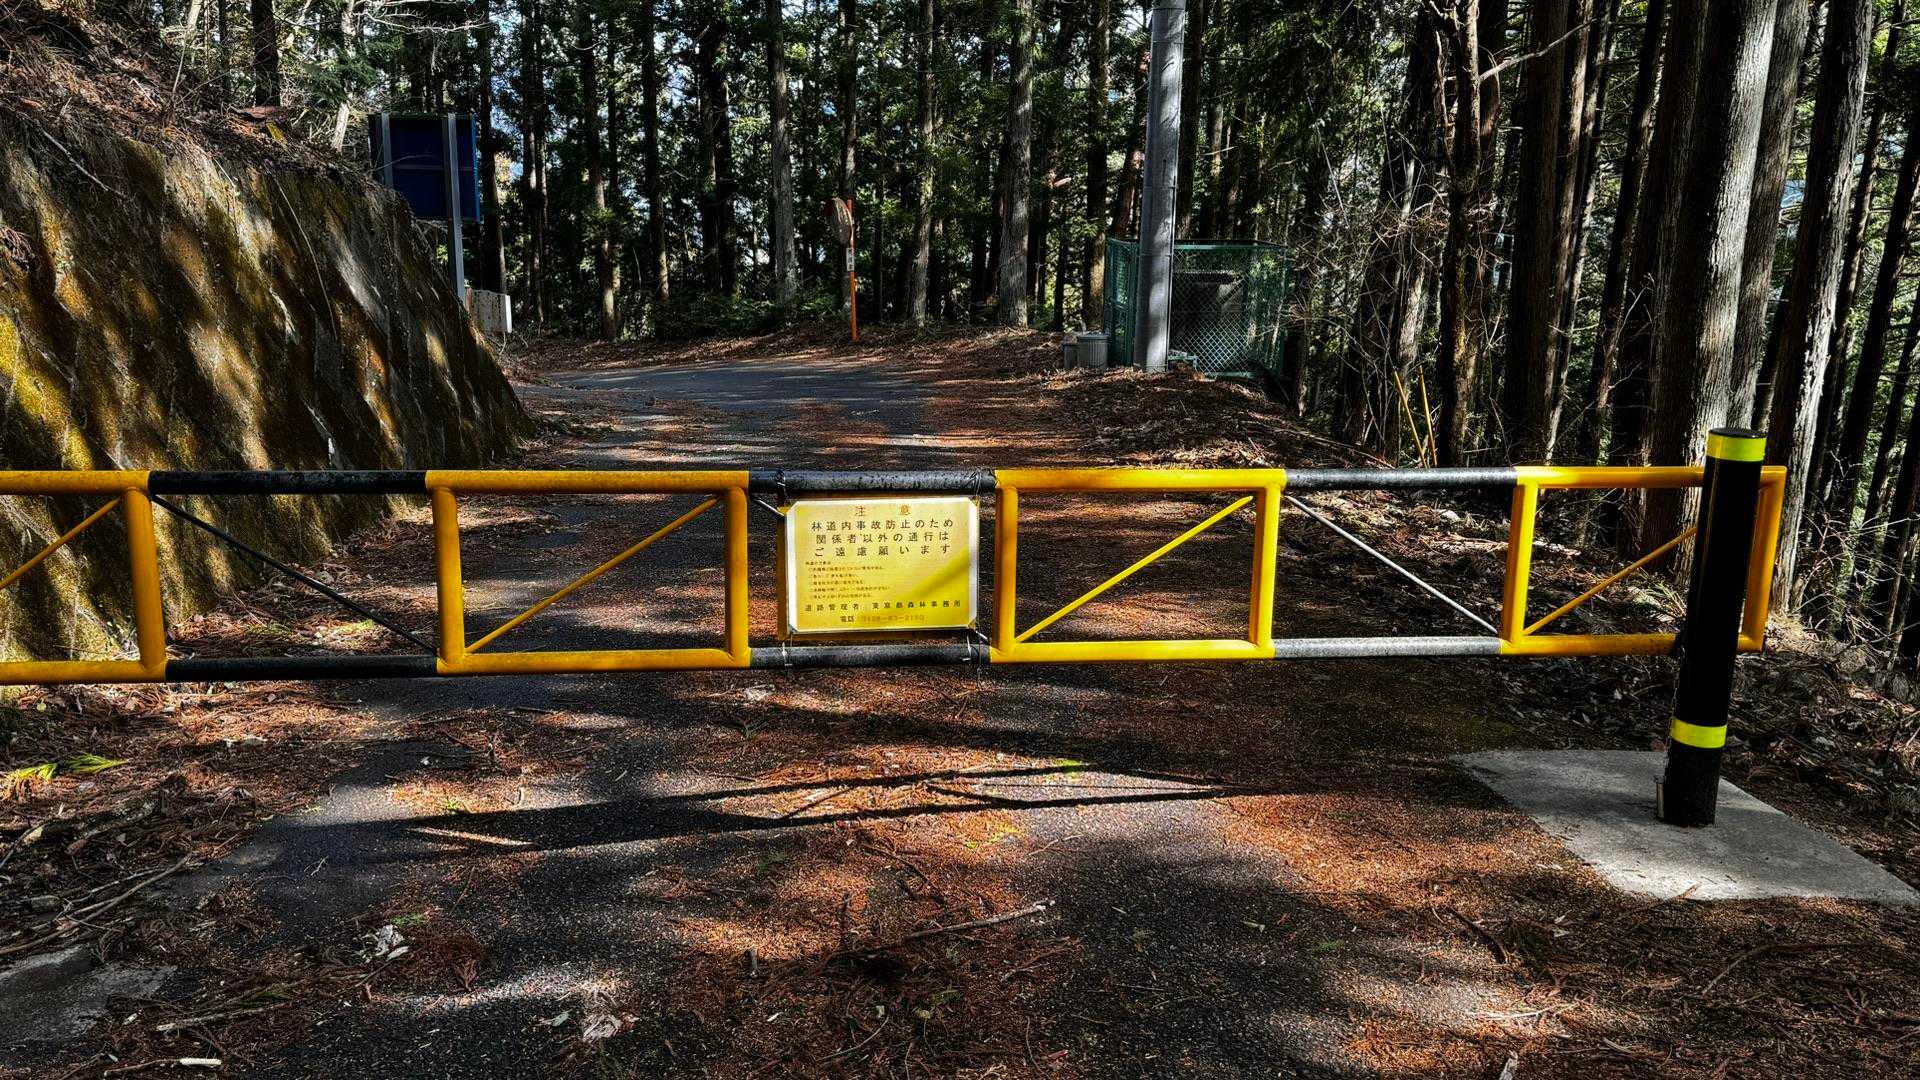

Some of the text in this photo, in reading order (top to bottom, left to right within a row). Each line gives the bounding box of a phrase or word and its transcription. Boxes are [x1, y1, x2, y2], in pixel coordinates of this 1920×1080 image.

[854, 505, 912, 517] 注意
[811, 518, 954, 532] 林道内事故防止のため
[815, 531, 950, 545] 関係者以外の通行は
[814, 544, 951, 557] ご遠慮願います
